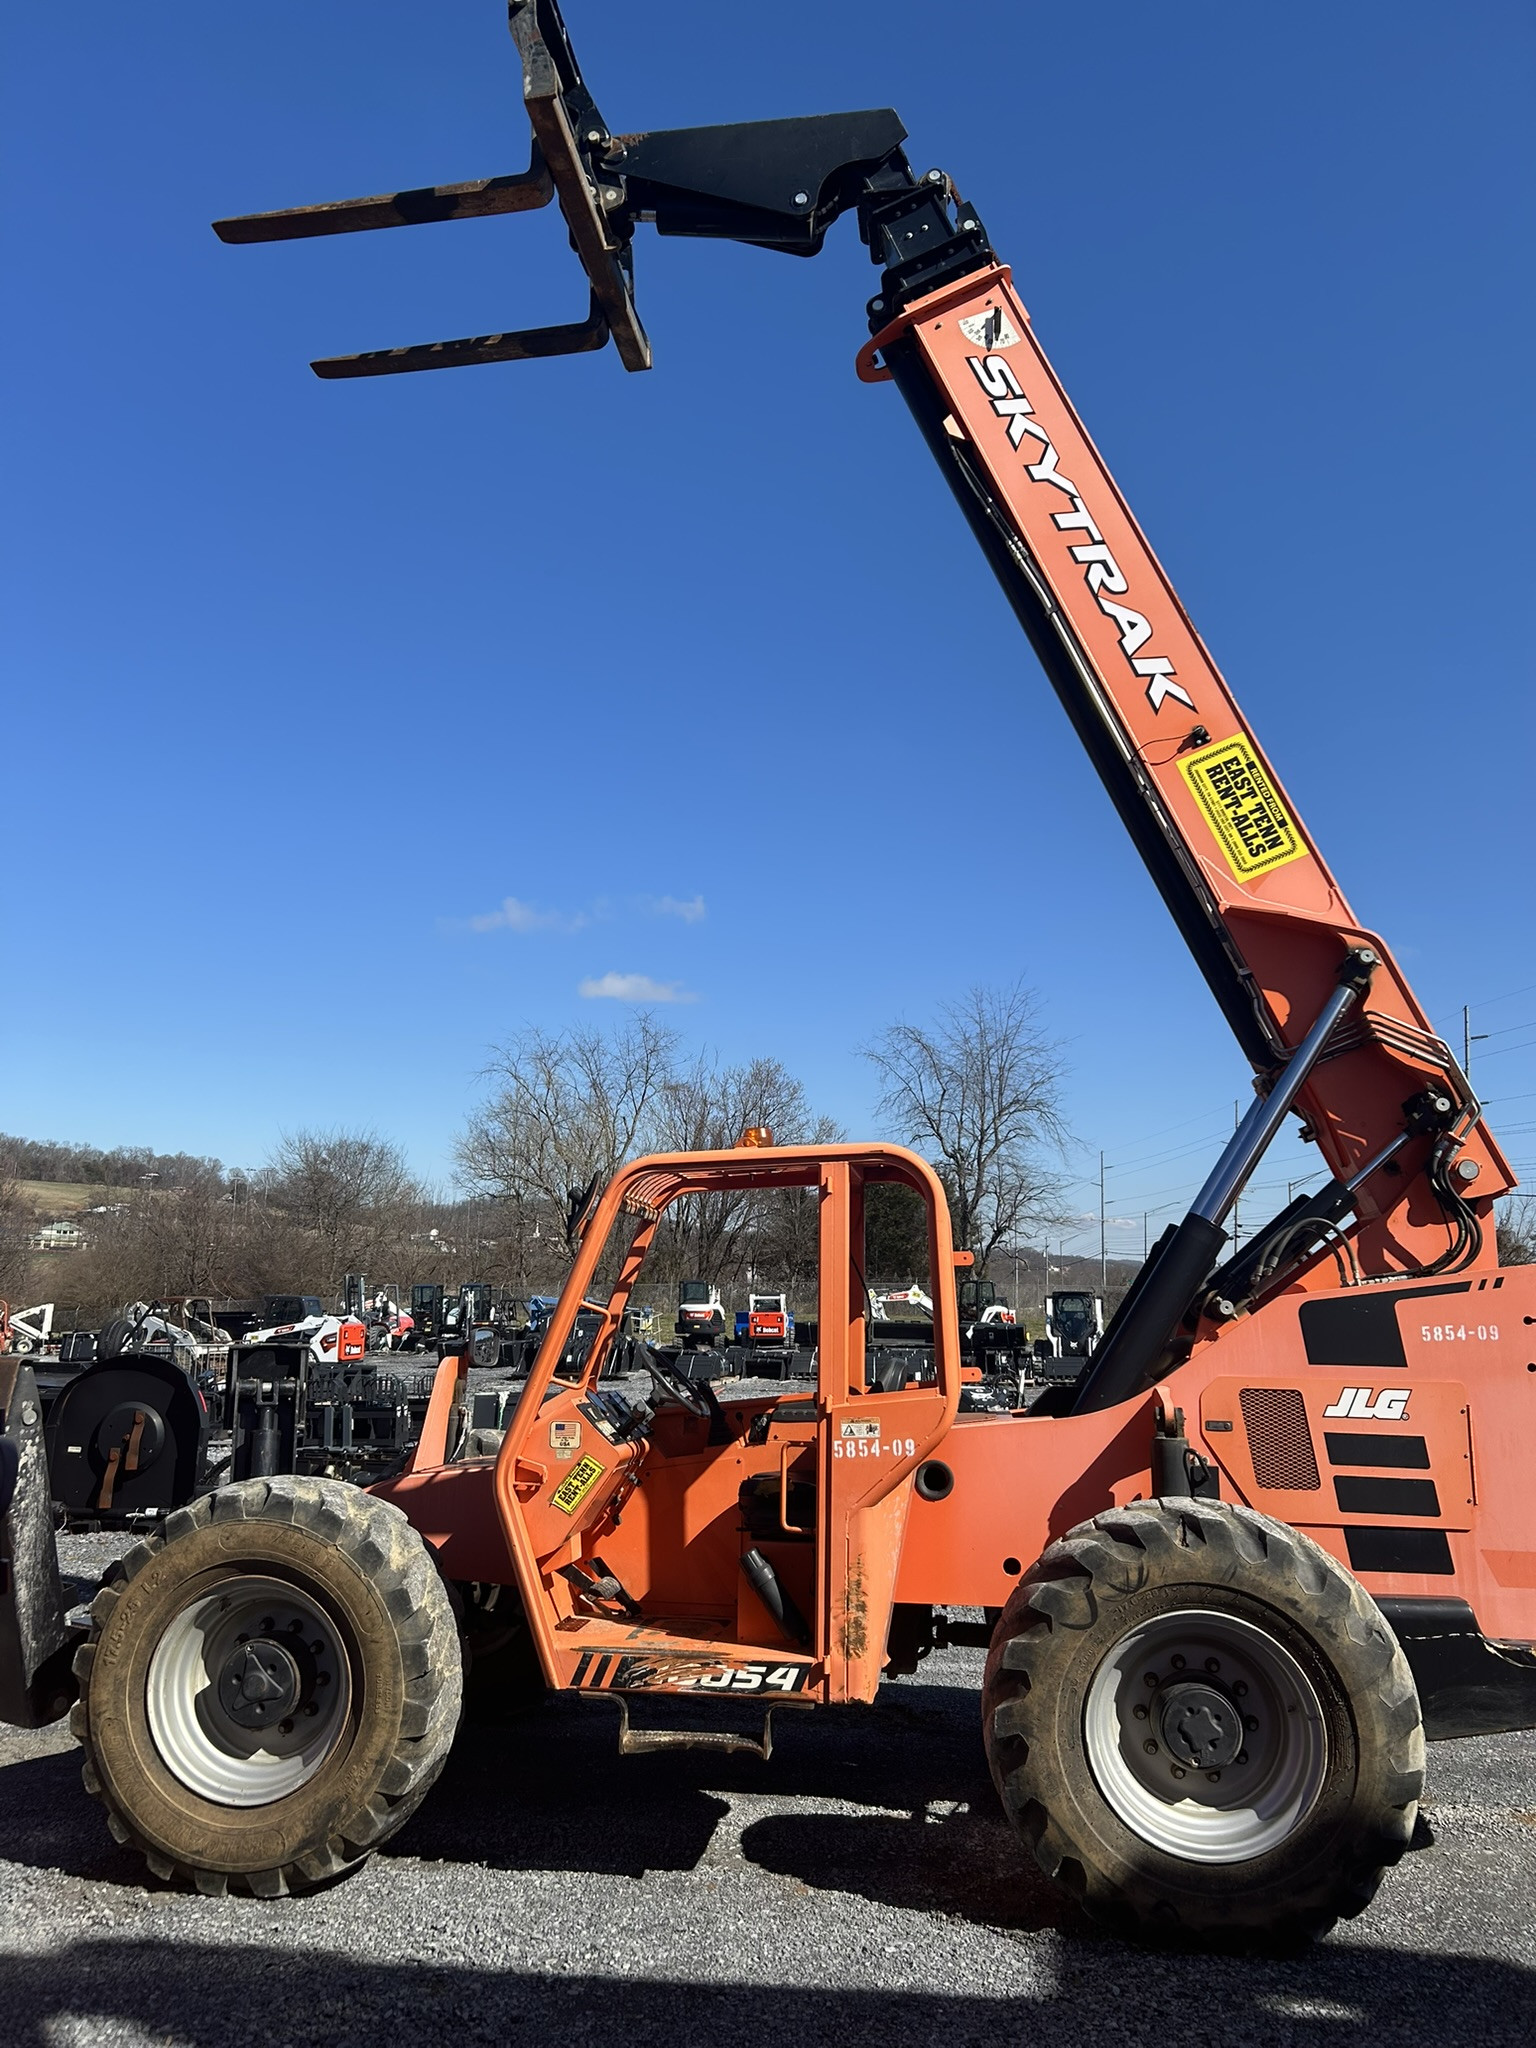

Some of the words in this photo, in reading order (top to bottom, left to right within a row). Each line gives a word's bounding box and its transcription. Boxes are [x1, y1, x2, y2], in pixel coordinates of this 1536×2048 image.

[965, 354, 1199, 715] SKYTRAK
[1204, 763, 1267, 859] RENT-ALLS
[1221, 755, 1259, 801] EAST
[1247, 801, 1285, 851] TENN
[1249, 767, 1271, 798] RENTED
[1266, 797, 1284, 822] FROM
[1422, 1325, 1499, 1341] 5854-09
[1322, 1387, 1412, 1420] JLG
[834, 1438, 916, 1459] 5854-09
[558, 1482, 574, 1501] EAST
[572, 1462, 591, 1481] TENN
[563, 1466, 597, 1506] RENT-ALLS
